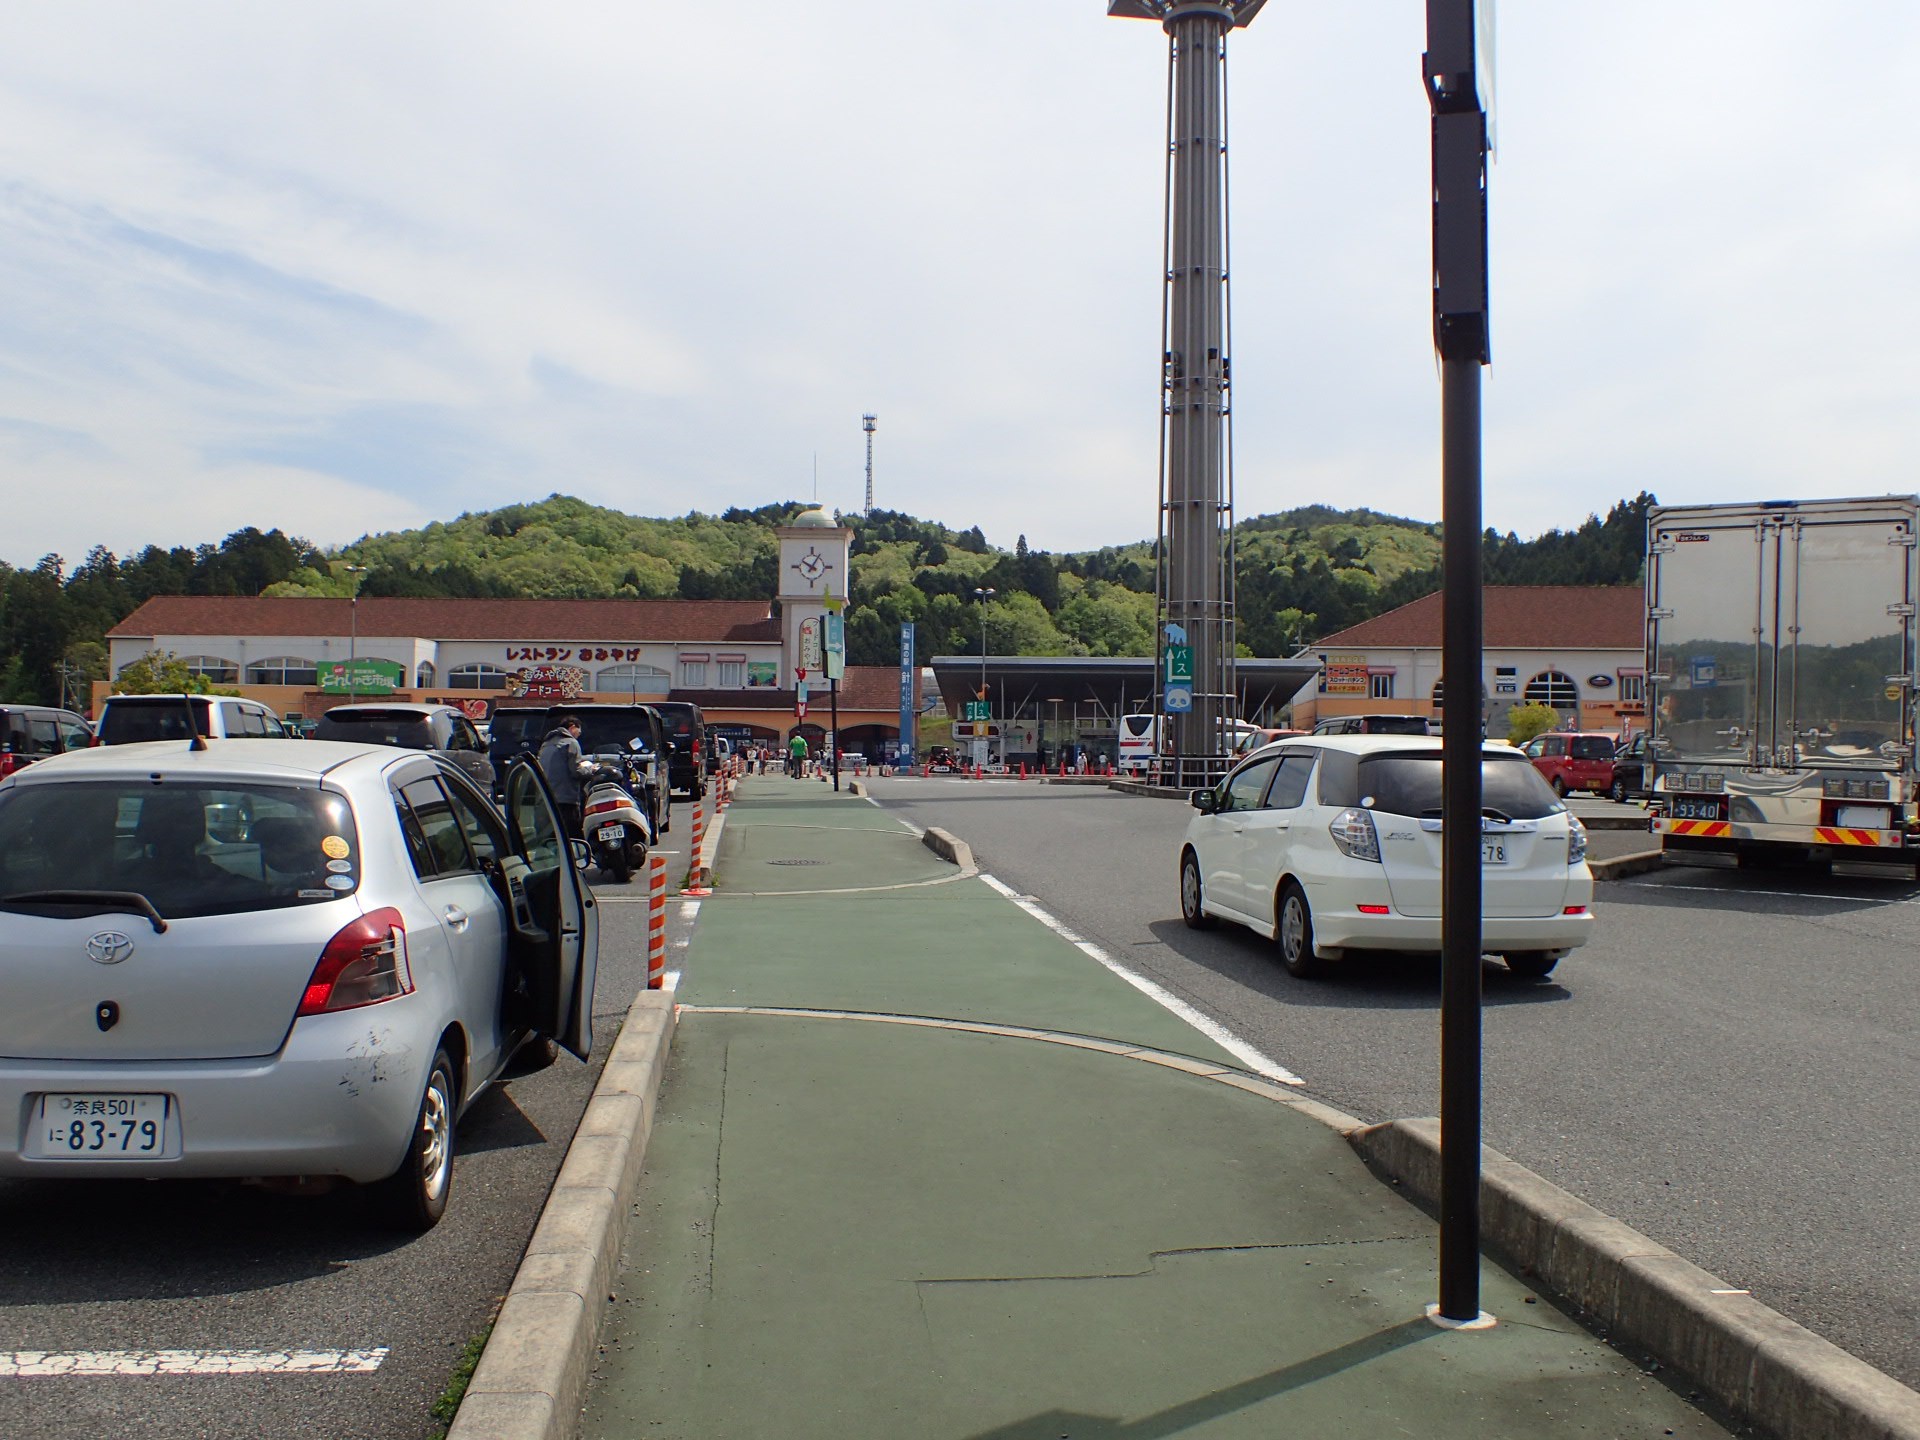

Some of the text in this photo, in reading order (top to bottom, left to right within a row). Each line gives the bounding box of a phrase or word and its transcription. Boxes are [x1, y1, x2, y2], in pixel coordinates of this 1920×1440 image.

[507, 647, 641, 662] レストラン おみやげ
[803, 638, 811, 668] おみやげ
[1177, 649, 1187, 673] バス
[523, 669, 567, 681] おみやげ
[522, 685, 567, 695] フードコート
[978, 703, 985, 715] バス
[1679, 804, 1716, 818] 93-40
[73, 1099, 135, 1116] 奈良501
[49, 1119, 157, 1151] に 83-79
